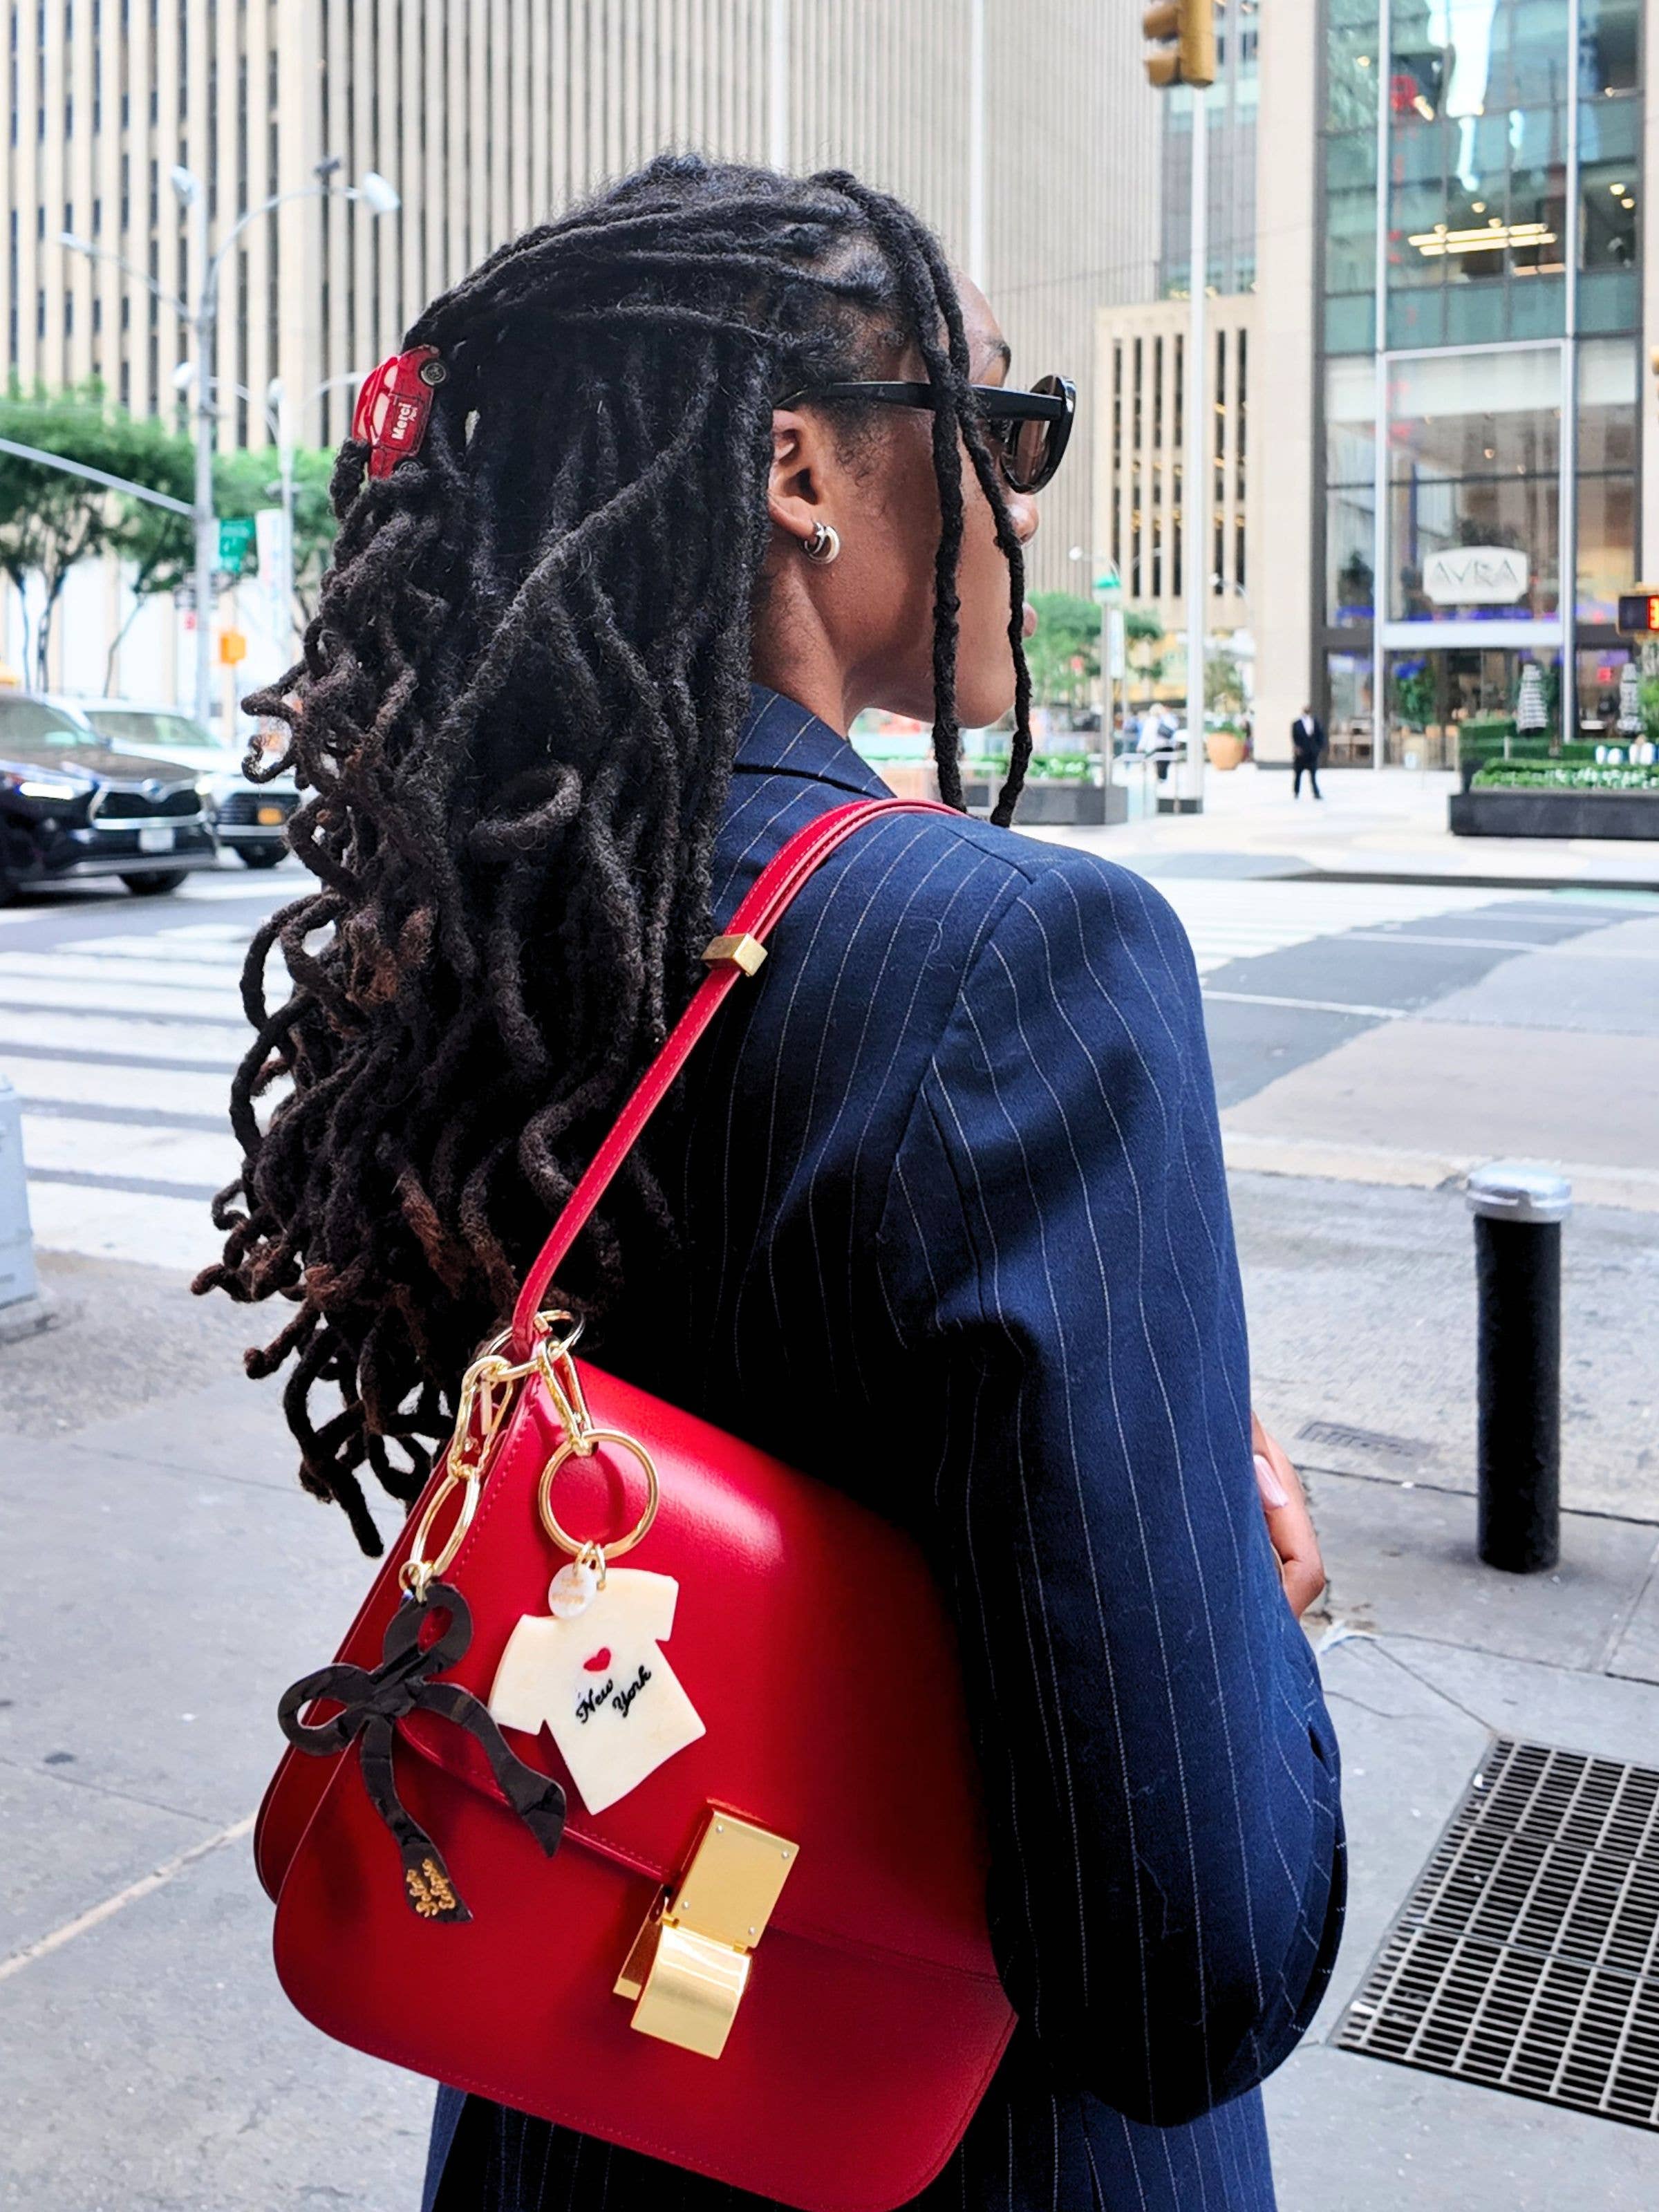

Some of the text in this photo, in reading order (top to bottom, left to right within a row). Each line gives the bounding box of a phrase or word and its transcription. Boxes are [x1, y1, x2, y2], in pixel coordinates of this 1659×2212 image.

[391, 402, 412, 440] Merci
[1430, 557, 1519, 588] AVRA
[575, 1678, 613, 1725] New
[612, 1664, 652, 1718] York
